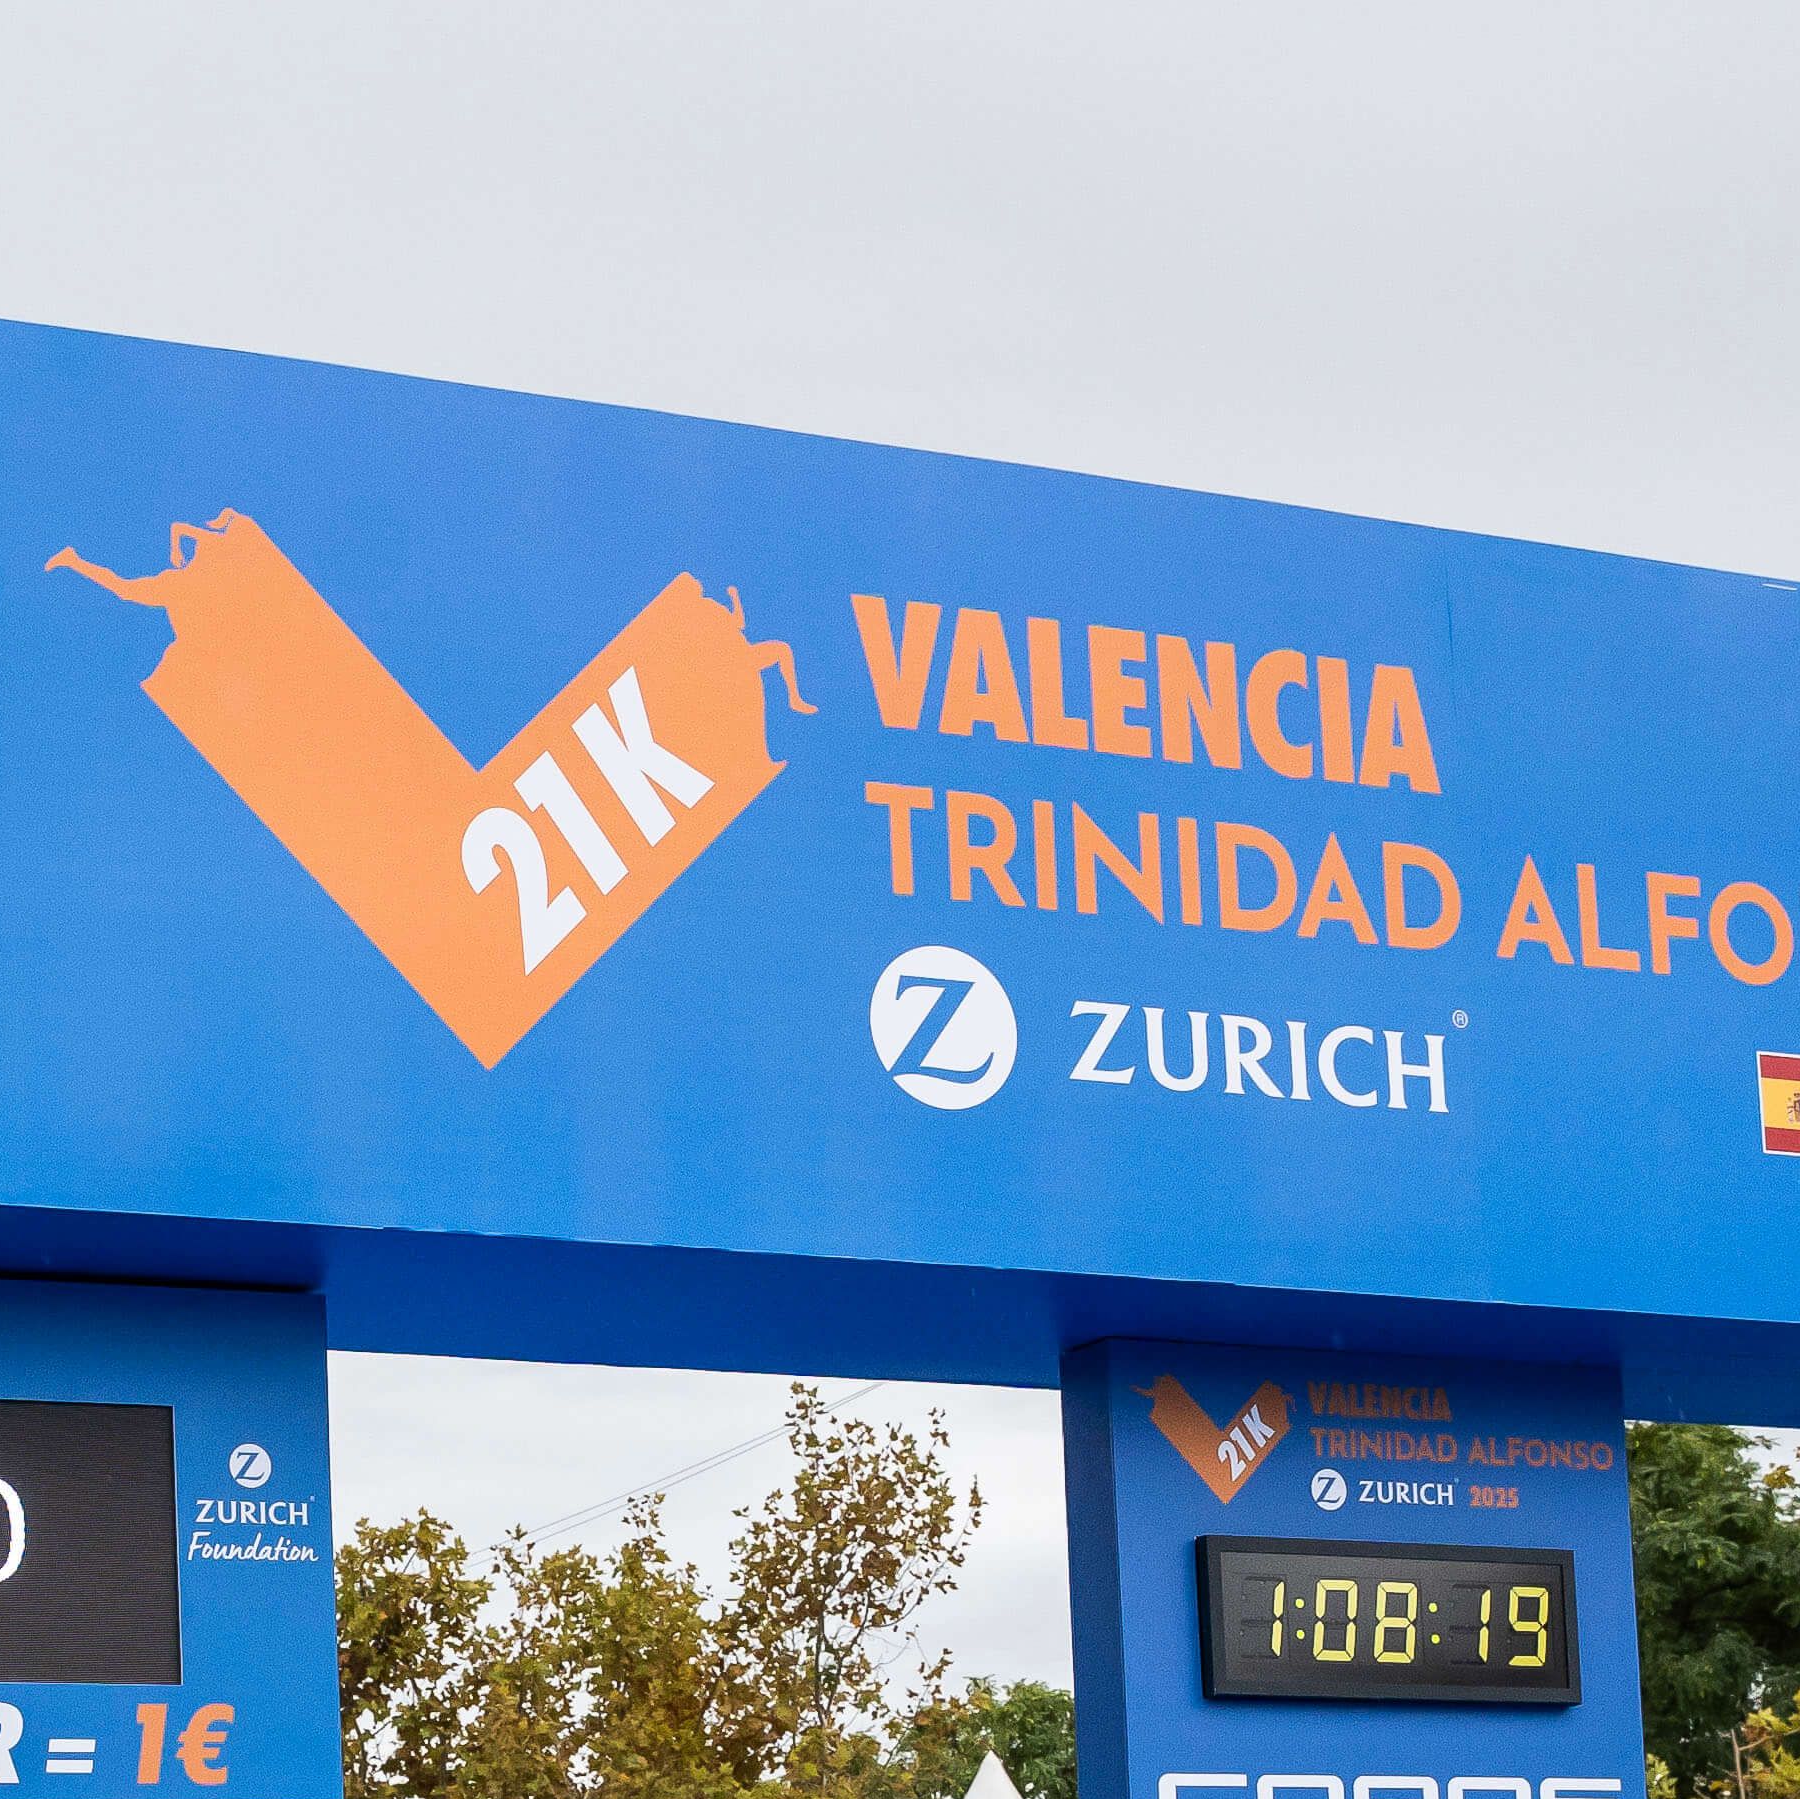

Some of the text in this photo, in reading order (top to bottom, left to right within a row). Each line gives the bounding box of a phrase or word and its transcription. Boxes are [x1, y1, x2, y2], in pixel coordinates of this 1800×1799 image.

[850, 593, 1441, 795] VALENCIA
[461, 665, 716, 977] 21K
[864, 781, 1461, 950] TRINIDAD
[1068, 1000, 1451, 1114] ZURICH
[1307, 1380, 1452, 1421] VALENCIA
[1217, 1403, 1276, 1482] 21K
[1310, 1427, 1614, 1471] TRINIDAD ALFONSO
[195, 1499, 309, 1526] ZURICH
[1359, 1480, 1455, 1507] ZURICH
[1469, 1485, 1519, 1509] 2025
[187, 1531, 319, 1562] Foundation
[1269, 1578, 1549, 1668] 1:08:19
[135, 1702, 236, 1786] 1€
